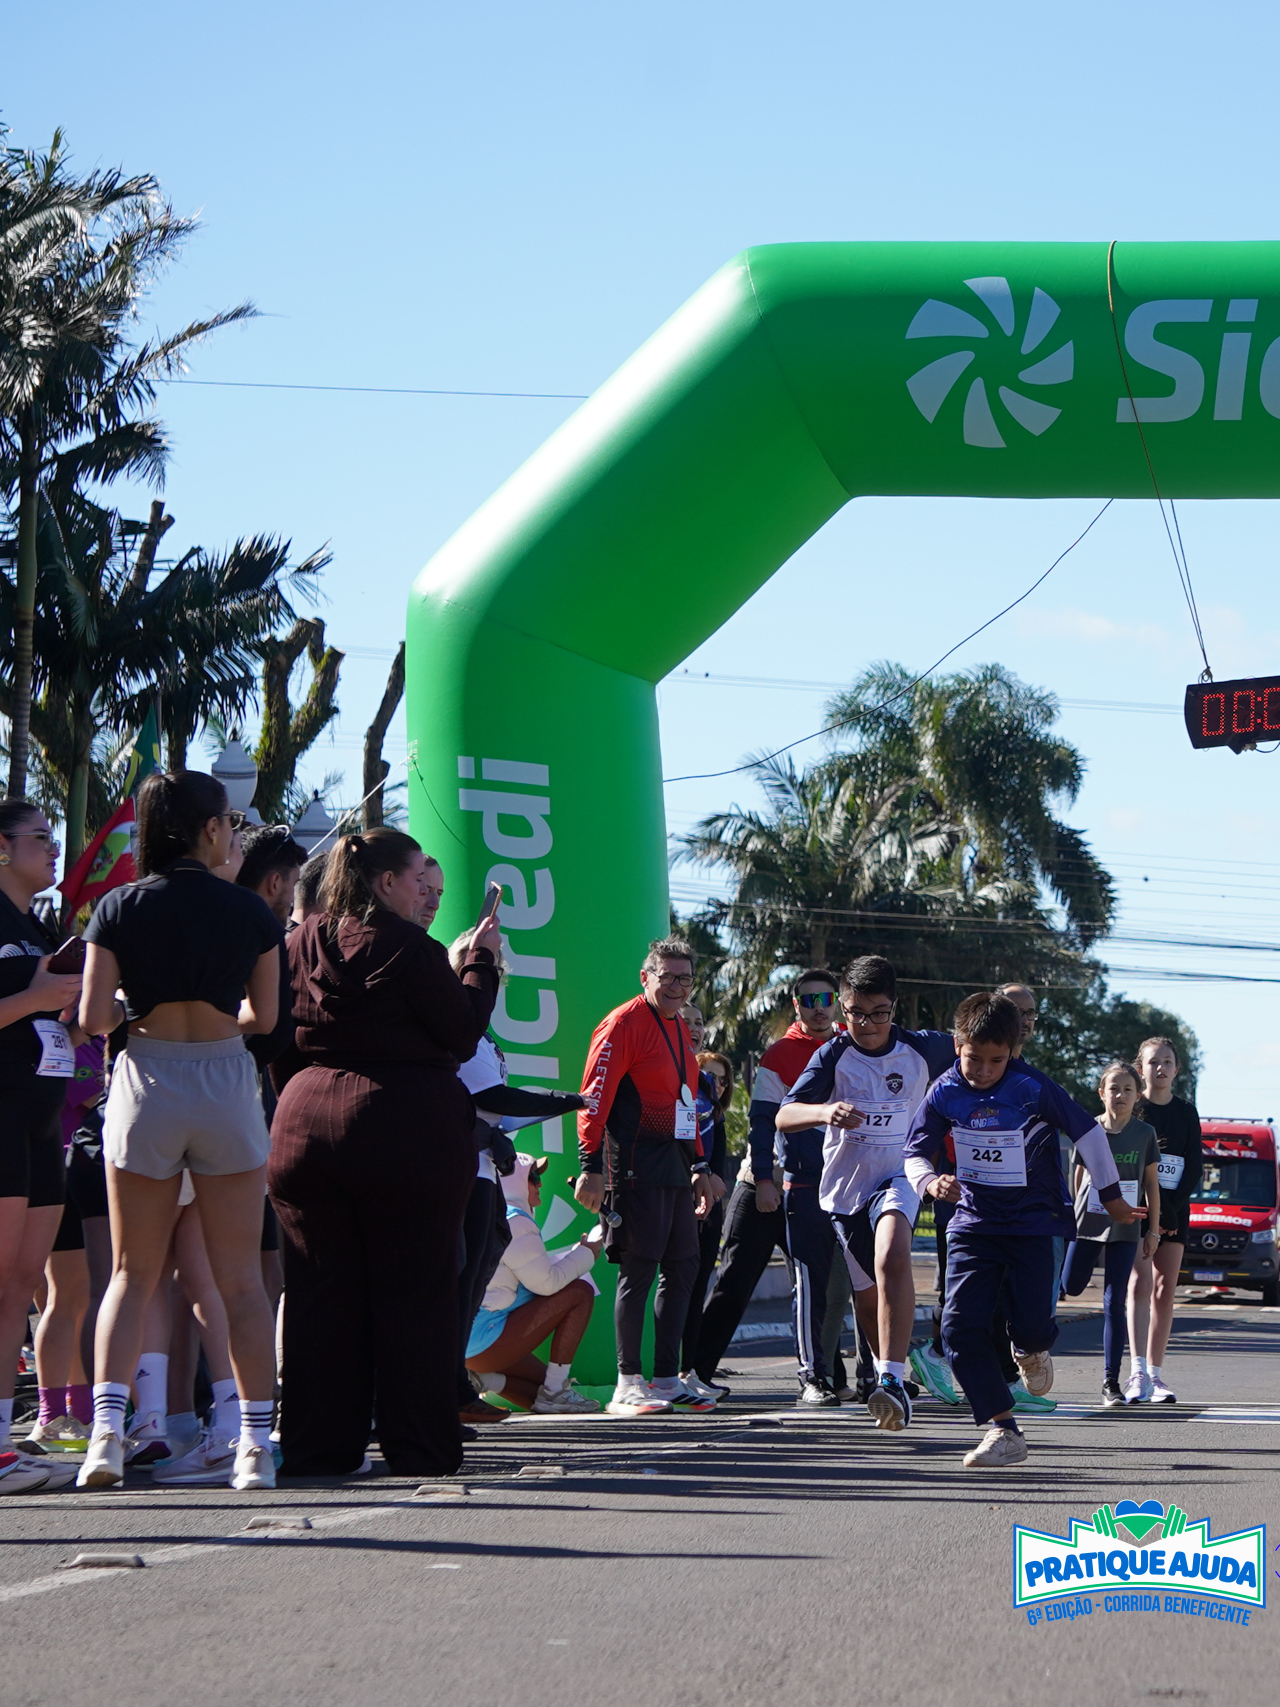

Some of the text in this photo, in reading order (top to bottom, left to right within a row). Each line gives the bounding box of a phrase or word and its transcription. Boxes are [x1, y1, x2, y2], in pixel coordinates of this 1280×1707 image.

[588, 1040, 612, 1115] ATLETISMO
[866, 1114, 893, 1126] 127
[972, 1148, 1003, 1162] 242
[1157, 1164, 1176, 1174] 030
